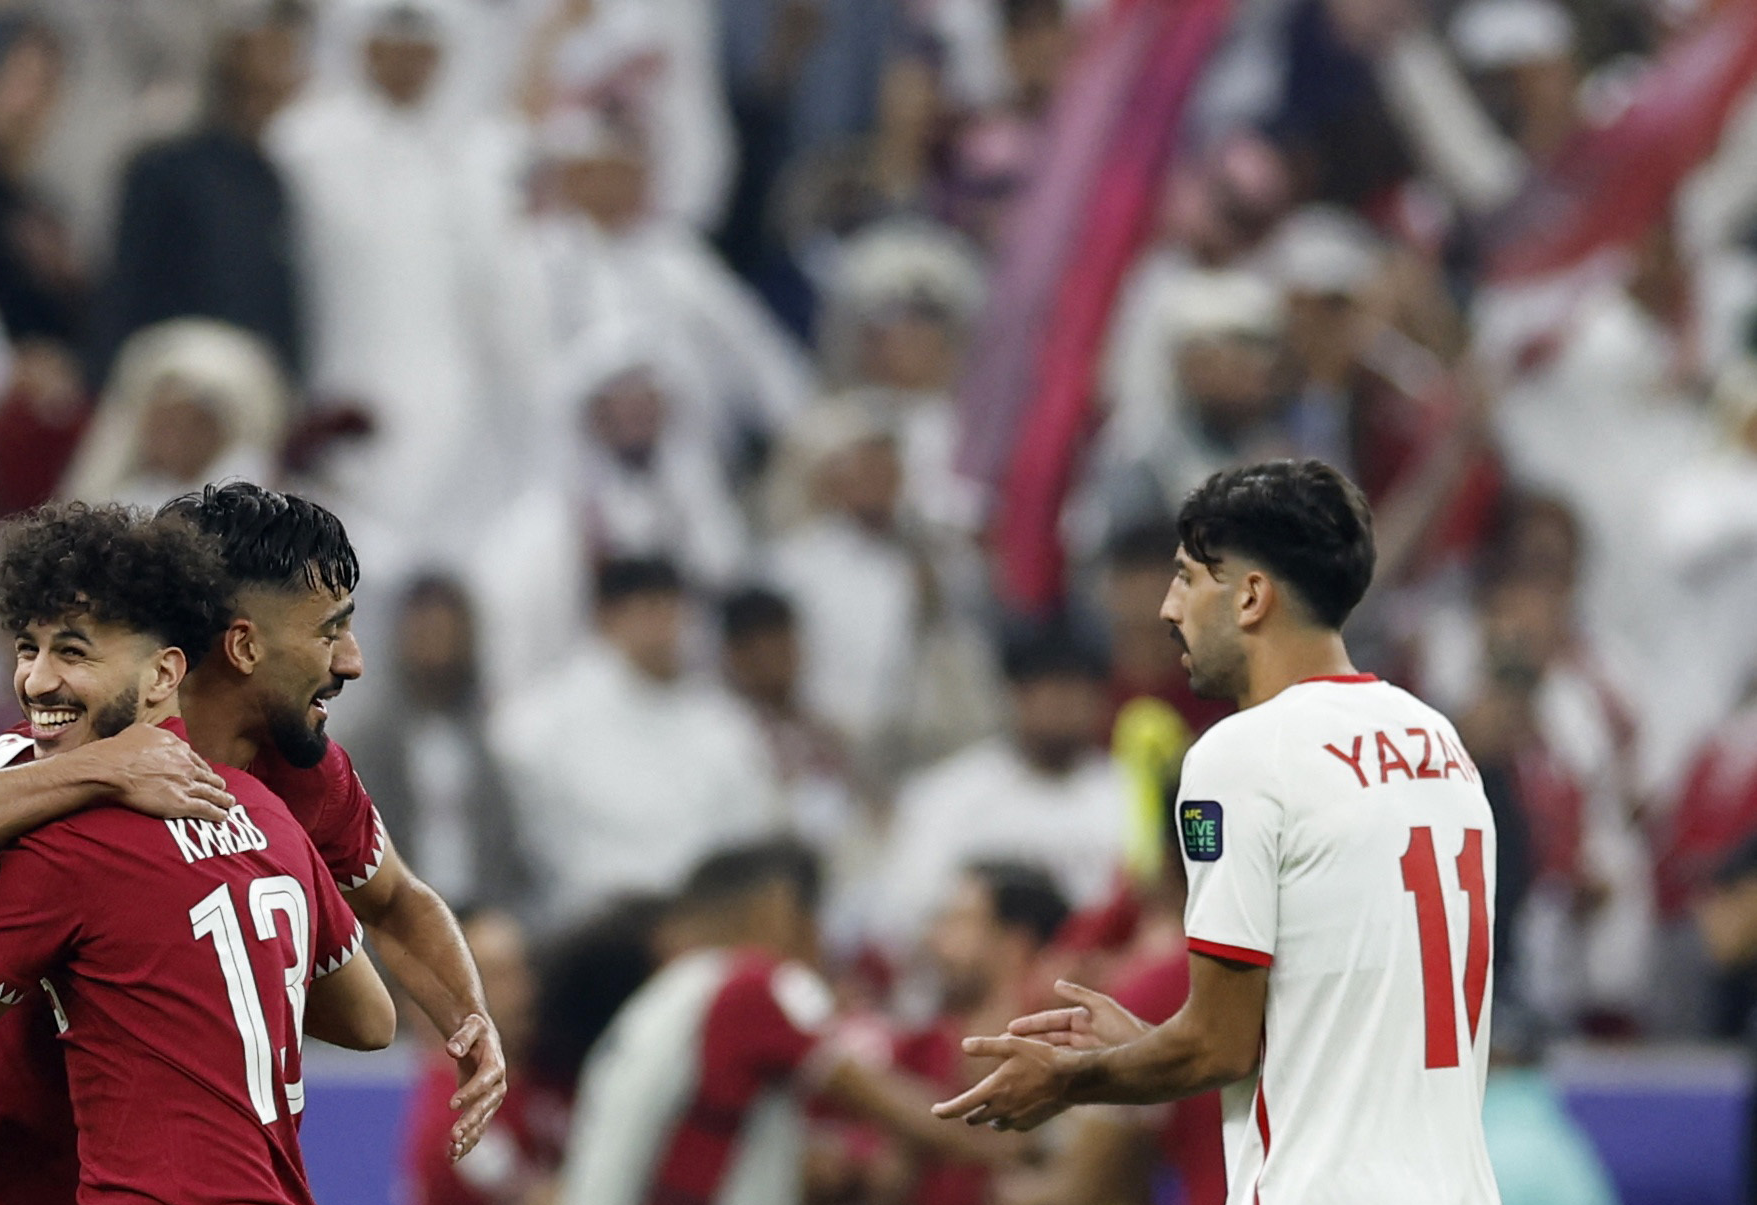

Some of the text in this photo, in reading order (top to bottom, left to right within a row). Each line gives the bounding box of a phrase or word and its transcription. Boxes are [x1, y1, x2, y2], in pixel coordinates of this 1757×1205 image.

[1323, 728, 1476, 788] YAZA
[1184, 809, 1202, 820] AFC
[1185, 820, 1216, 836] LIVE
[1400, 826, 1490, 1070] 11
[189, 874, 310, 1126] 13
